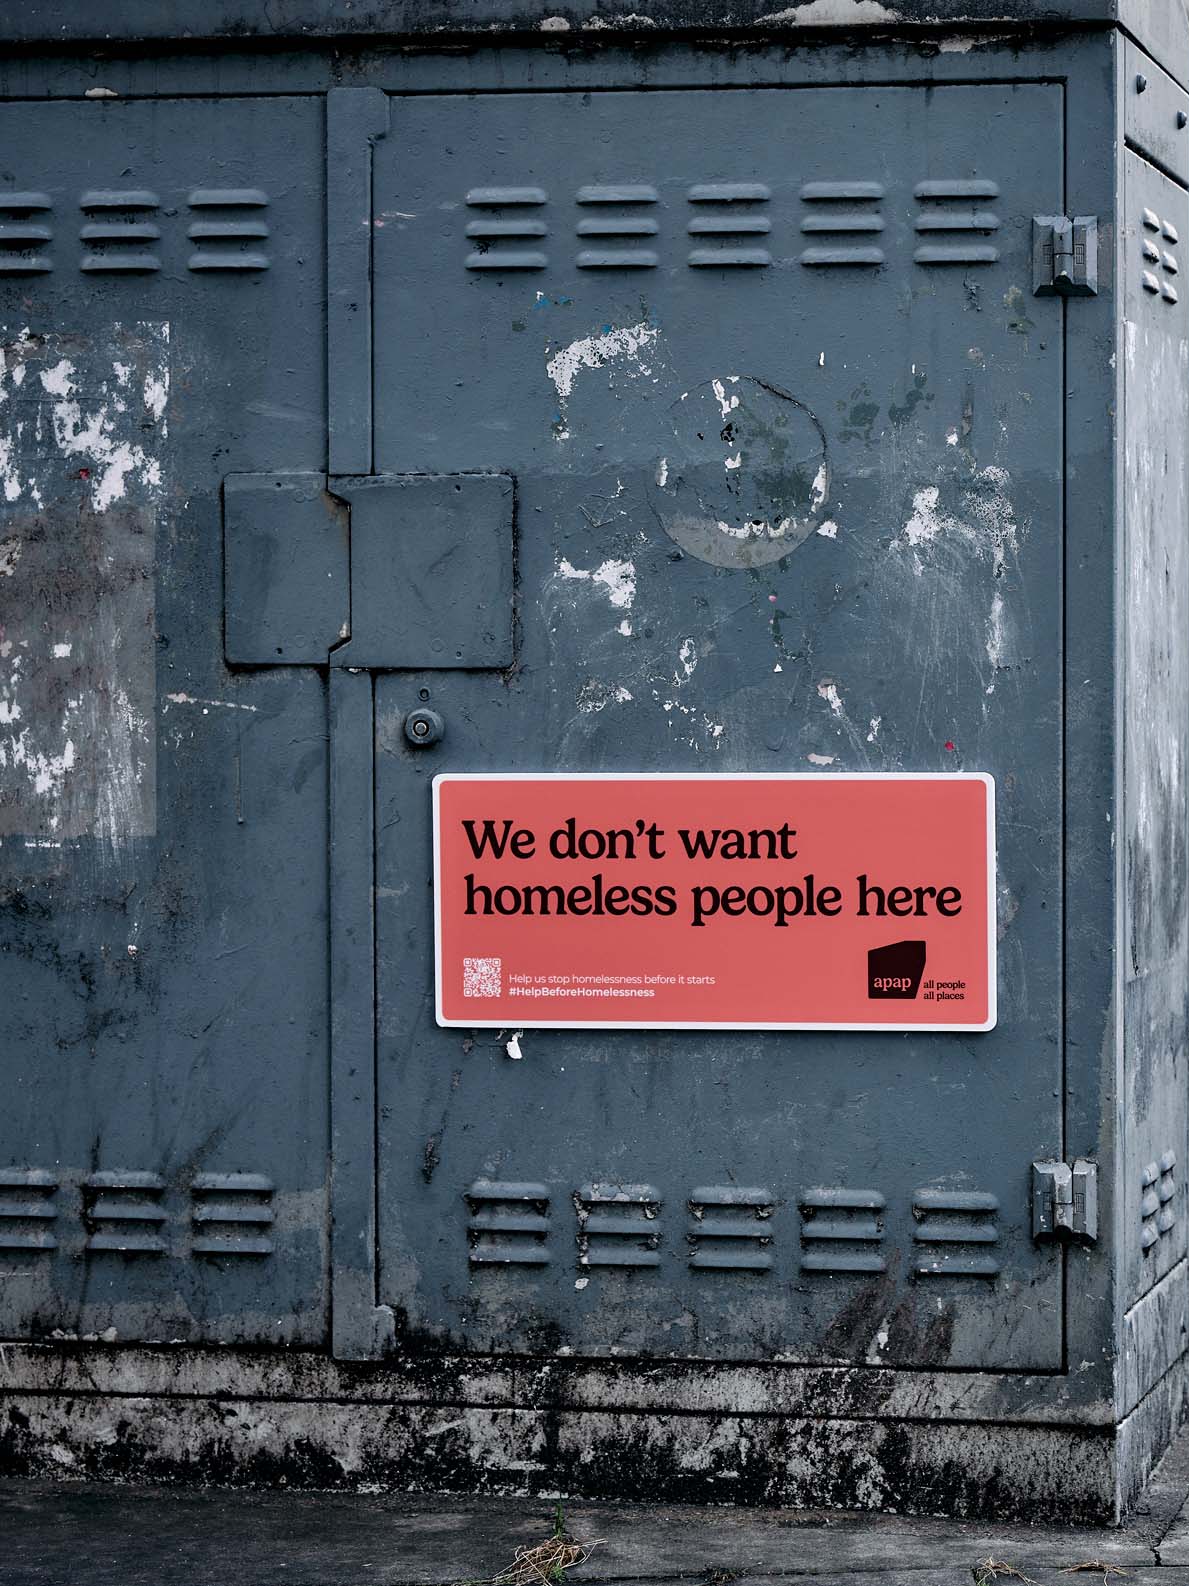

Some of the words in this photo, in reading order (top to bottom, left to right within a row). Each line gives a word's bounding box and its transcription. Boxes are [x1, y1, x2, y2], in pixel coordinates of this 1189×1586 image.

[461, 819, 536, 860] We
[549, 817, 667, 860] don’t
[677, 822, 798, 860] want
[463, 873, 678, 917] homeless
[690, 873, 843, 928] people
[856, 873, 963, 917] here
[509, 973, 532, 985] Help
[534, 975, 546, 984] us
[548, 974, 570, 985] stop
[572, 973, 642, 985] homelessness
[644, 974, 676, 985] before
[678, 974, 685, 985] it
[687, 975, 716, 985] starts
[873, 977, 912, 992] apap
[923, 980, 935, 989] all
[936, 980, 966, 991] people
[509, 986, 656, 998] #HelpBeforeHomelessness
[923, 991, 935, 1001] all
[936, 991, 965, 1002] places
